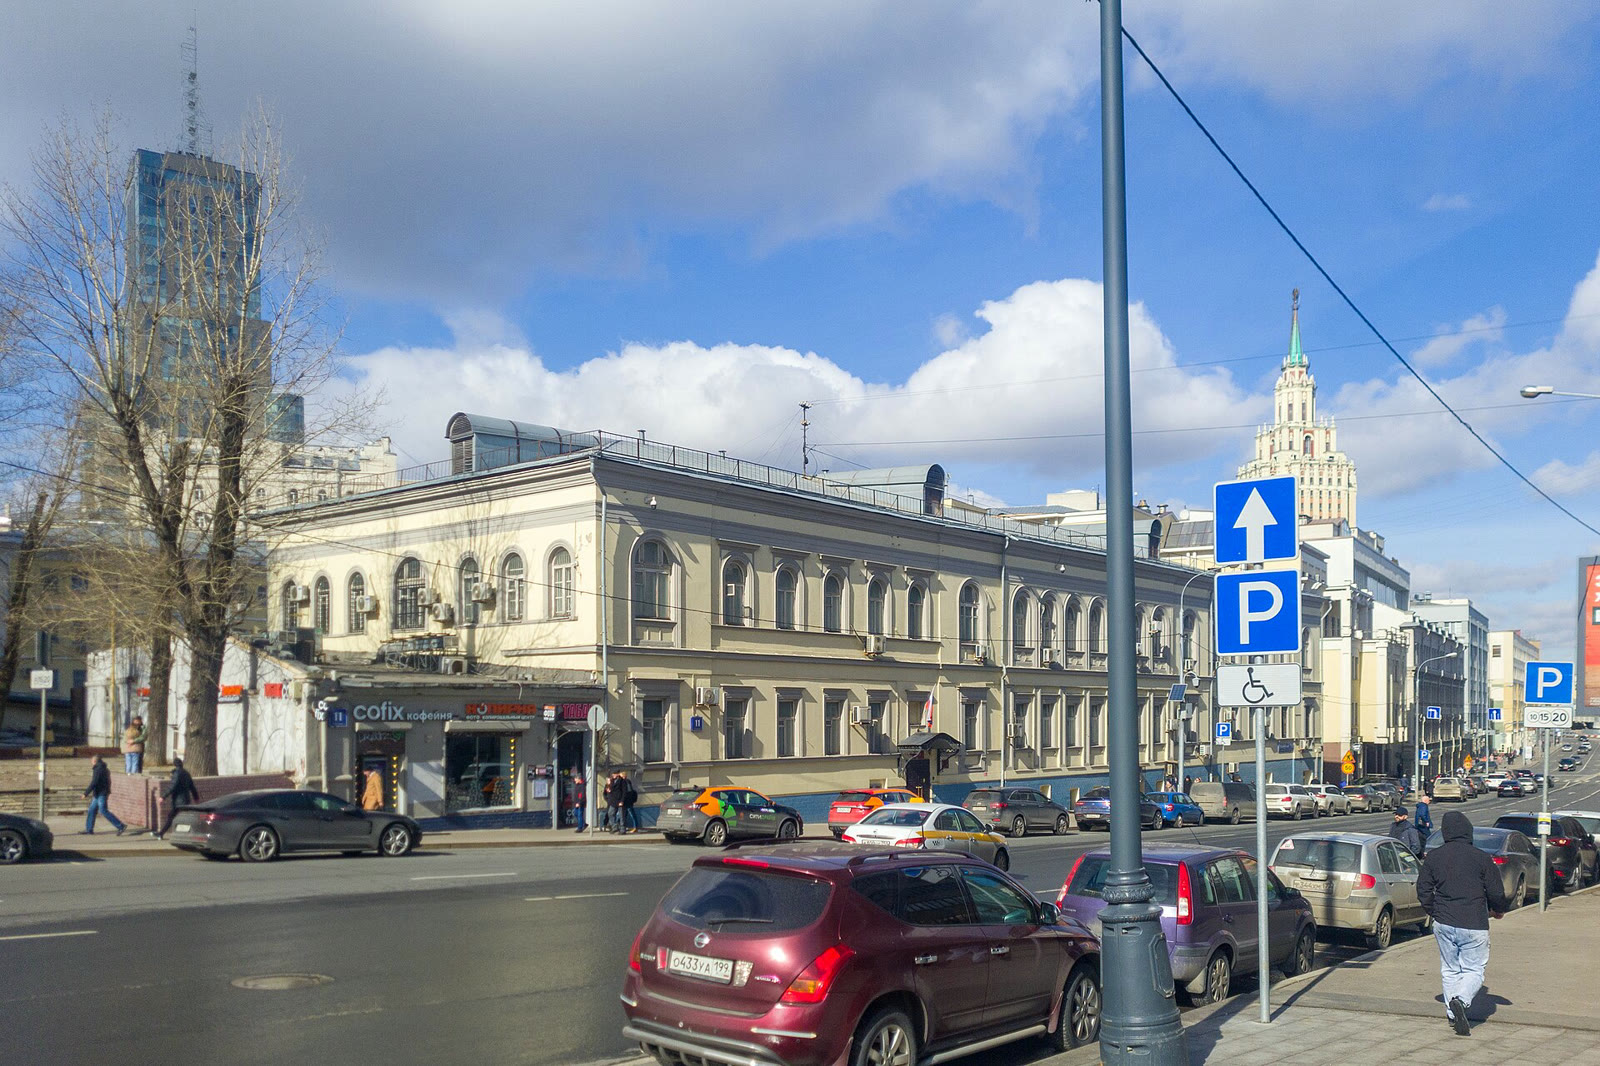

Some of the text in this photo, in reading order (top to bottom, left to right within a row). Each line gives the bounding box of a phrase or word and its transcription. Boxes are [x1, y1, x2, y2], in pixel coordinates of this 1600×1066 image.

[1239, 581, 1284, 645] P
[1537, 667, 1563, 698] P
[334, 712, 343, 722] 11
[353, 701, 405, 721] cofix
[406, 710, 453, 723] кофейня
[563, 703, 593, 719] ТАБА
[1540, 713, 1549, 721] 15
[1552, 712, 1567, 722] 20
[695, 719, 701, 727] 11
[1219, 724, 1228, 736] P
[1420, 751, 1428, 760] P
[713, 961, 729, 973] 199
